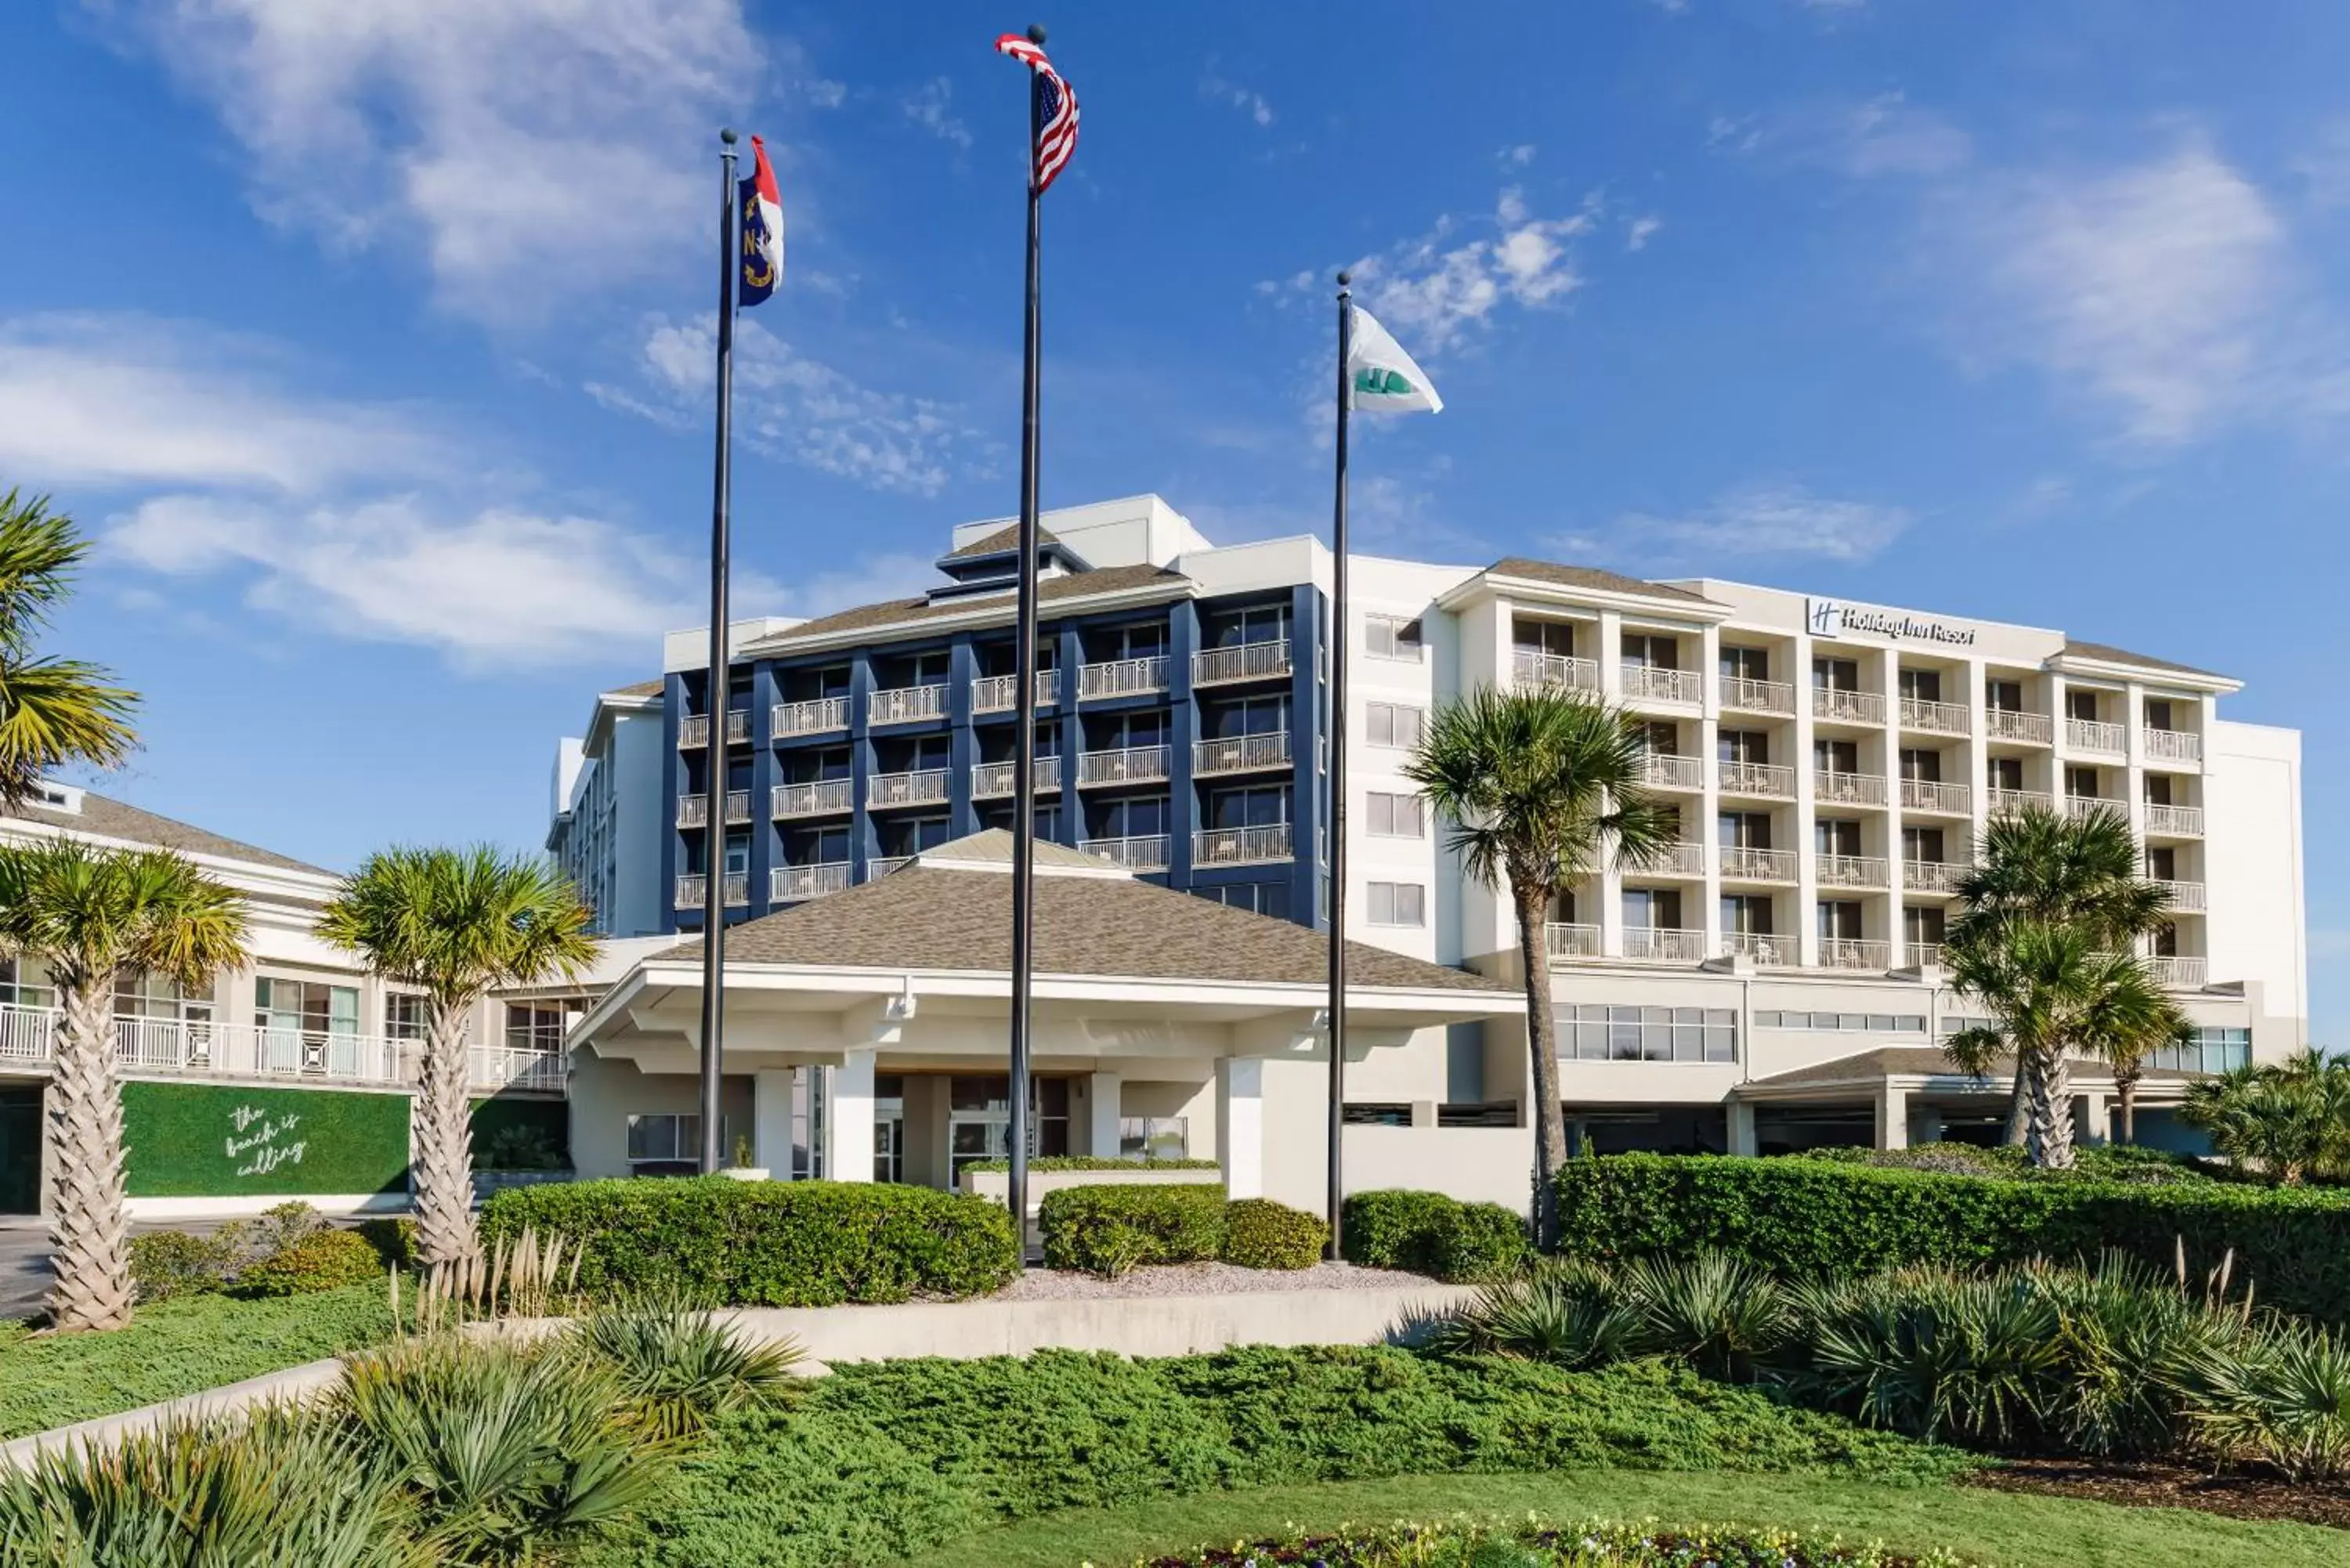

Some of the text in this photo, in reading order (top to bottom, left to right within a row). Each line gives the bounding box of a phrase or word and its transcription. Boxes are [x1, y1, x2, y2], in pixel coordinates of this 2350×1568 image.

[1842, 609, 1976, 646] Holiday Inn Resort
[226, 1114, 300, 1158] beach is
[228, 1104, 265, 1132] the
[237, 1141, 307, 1176] calling
